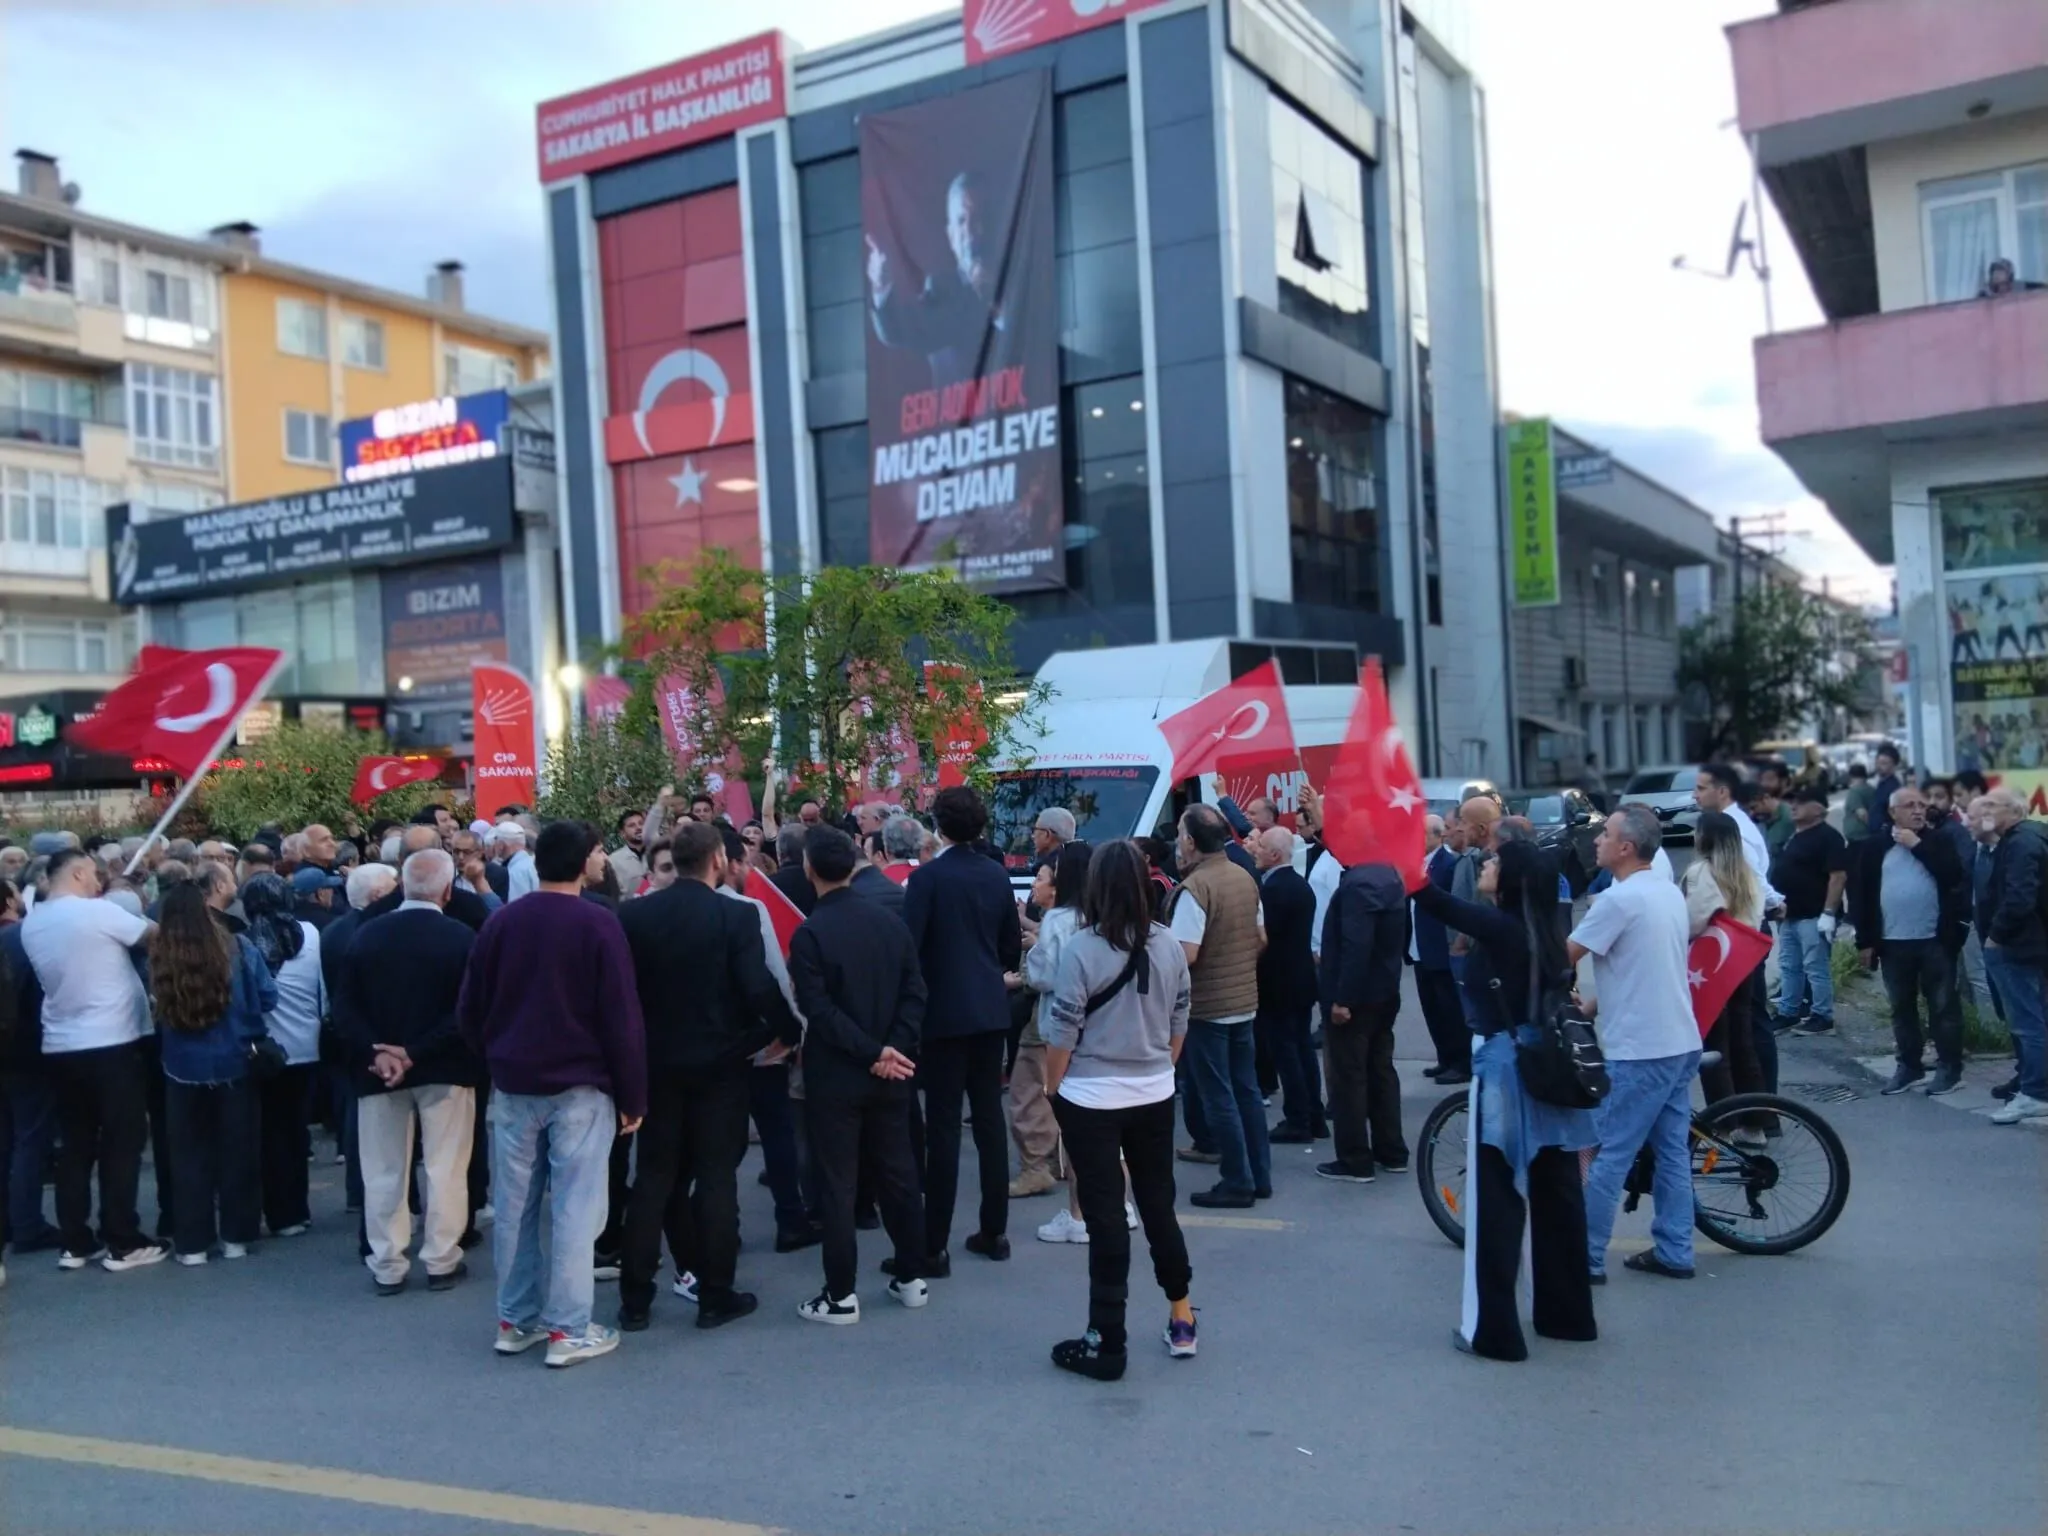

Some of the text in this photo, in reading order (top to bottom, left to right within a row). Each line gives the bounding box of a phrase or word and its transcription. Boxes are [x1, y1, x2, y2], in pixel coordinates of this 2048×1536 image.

[652, 74, 698, 103] HALK
[545, 121, 629, 164] SAKARYA
[653, 75, 771, 133] BAŞKANLIĞI
[917, 463, 1016, 521] DEVAM
[252, 520, 277, 541] VE
[949, 740, 972, 751] CHP
[493, 752, 517, 764] CHP
[479, 766, 534, 778] SAKARYA
